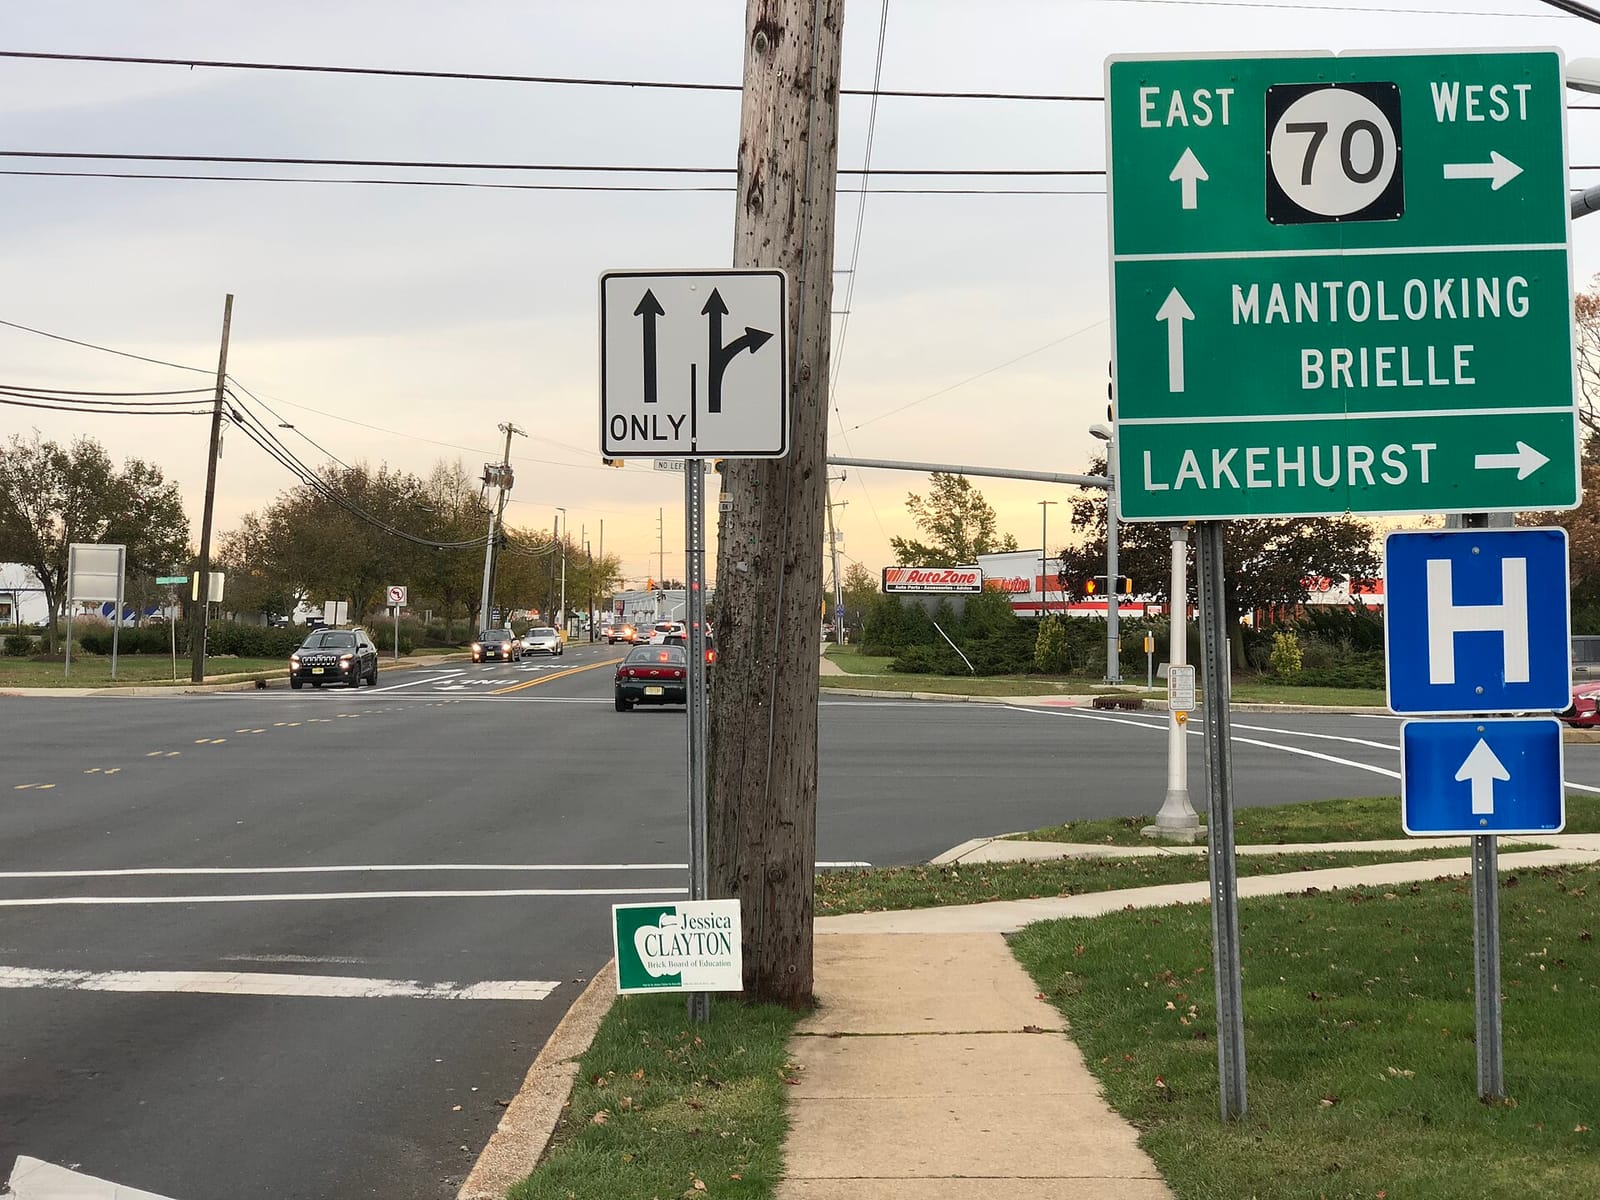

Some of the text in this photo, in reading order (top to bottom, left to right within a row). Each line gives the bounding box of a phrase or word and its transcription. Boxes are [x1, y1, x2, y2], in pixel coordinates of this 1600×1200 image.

[1140, 87, 1234, 128] EAST
[1430, 82, 1531, 122] WEST
[1286, 120, 1384, 185] 70
[1232, 276, 1529, 325] MANTOLOKING
[1301, 345, 1475, 390] BRIELLE
[610, 414, 686, 441] ONLY
[670, 462, 685, 470] LEF
[1143, 443, 1437, 491] LAKEHURST
[906, 569, 976, 584] AutoZone
[1427, 557, 1530, 685] H
[681, 912, 731, 930] Jessica
[645, 932, 731, 957] CLAYTON
[648, 959, 732, 968] Brick Board of Education
